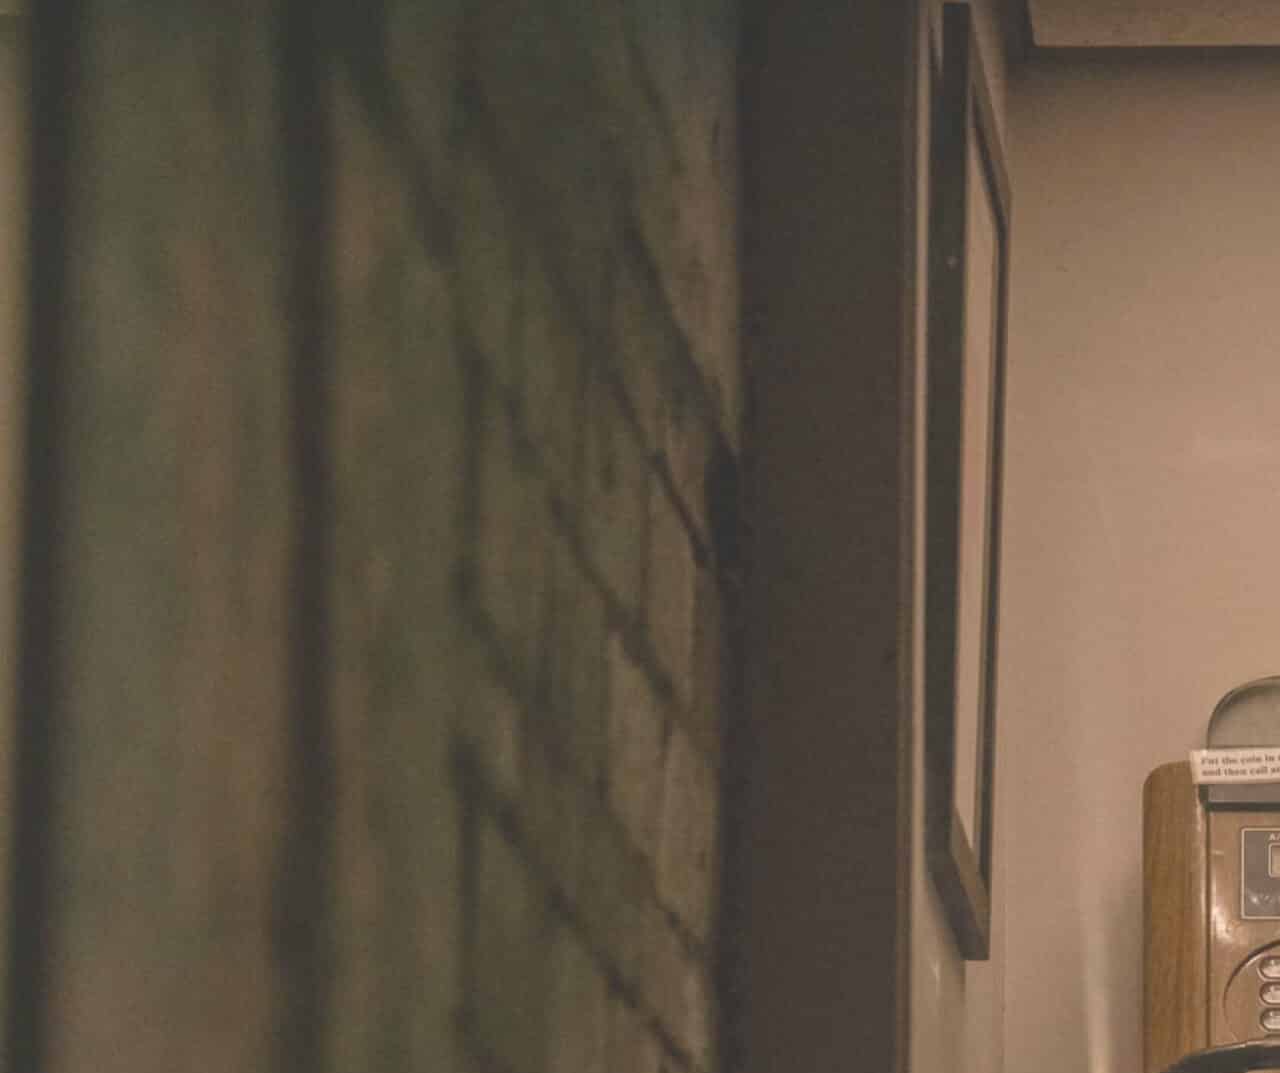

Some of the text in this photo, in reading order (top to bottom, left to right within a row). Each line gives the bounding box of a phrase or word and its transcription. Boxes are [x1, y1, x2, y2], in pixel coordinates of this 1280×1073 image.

[1222, 756, 1238, 764] the
[1265, 754, 1275, 762] in
[1202, 767, 1221, 776] and
[1224, 767, 1247, 776] then
[1250, 766, 1268, 775] call
